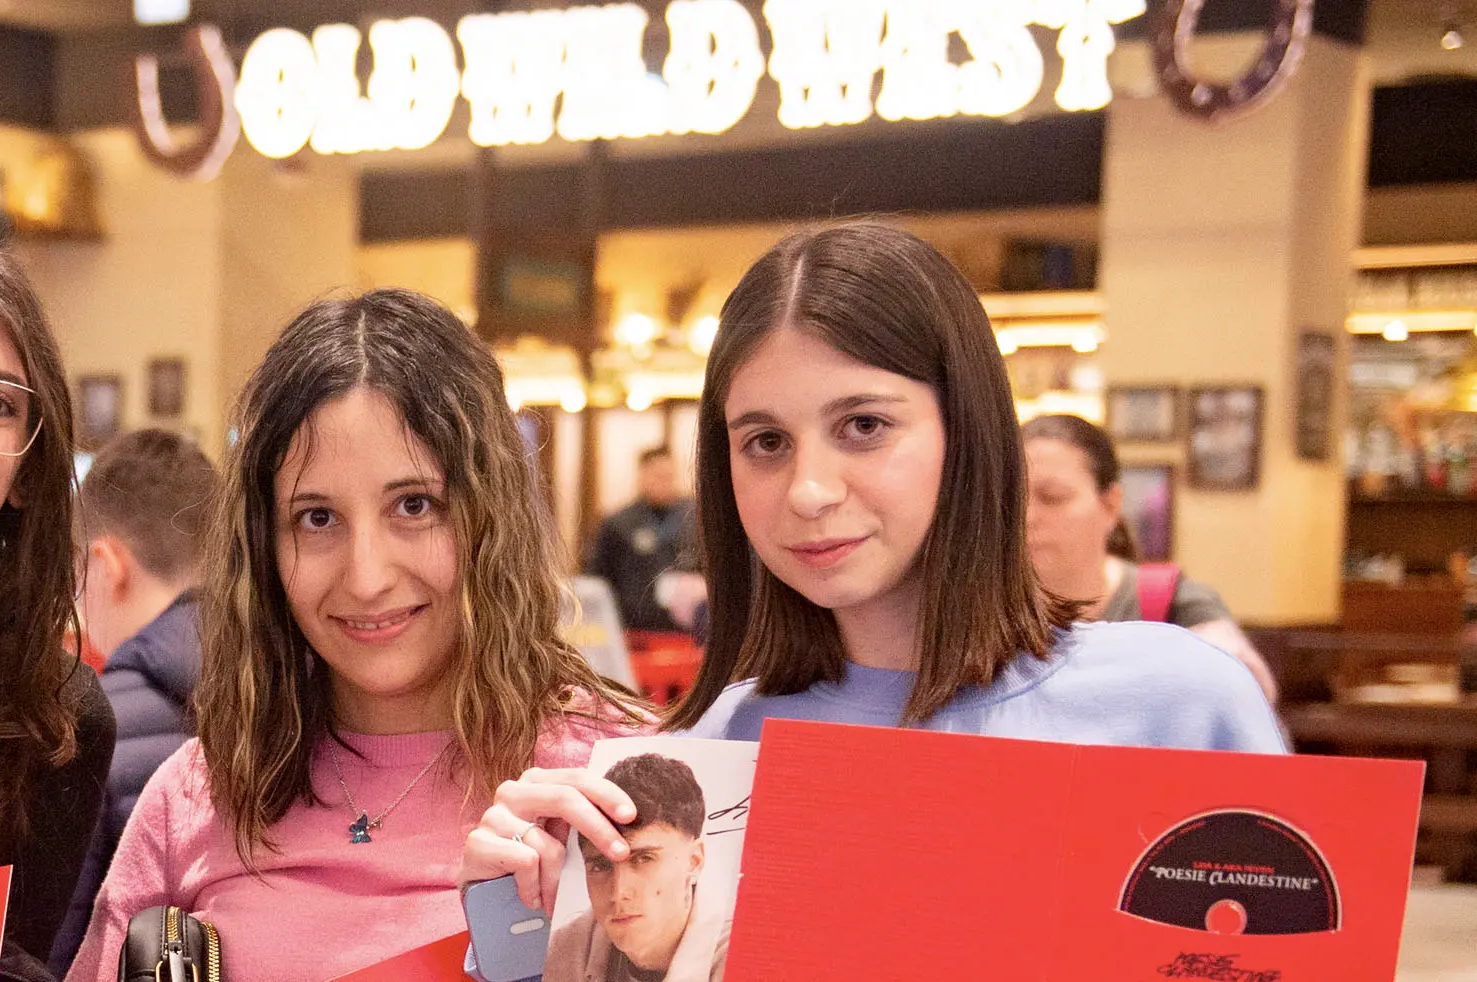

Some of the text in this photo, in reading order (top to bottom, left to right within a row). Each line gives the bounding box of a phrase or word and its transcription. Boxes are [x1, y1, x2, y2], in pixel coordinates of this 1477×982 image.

[233, 0, 1148, 158] OLD WILD WEST
[1149, 865, 1319, 891] "POESIE CLANDESTINE"
